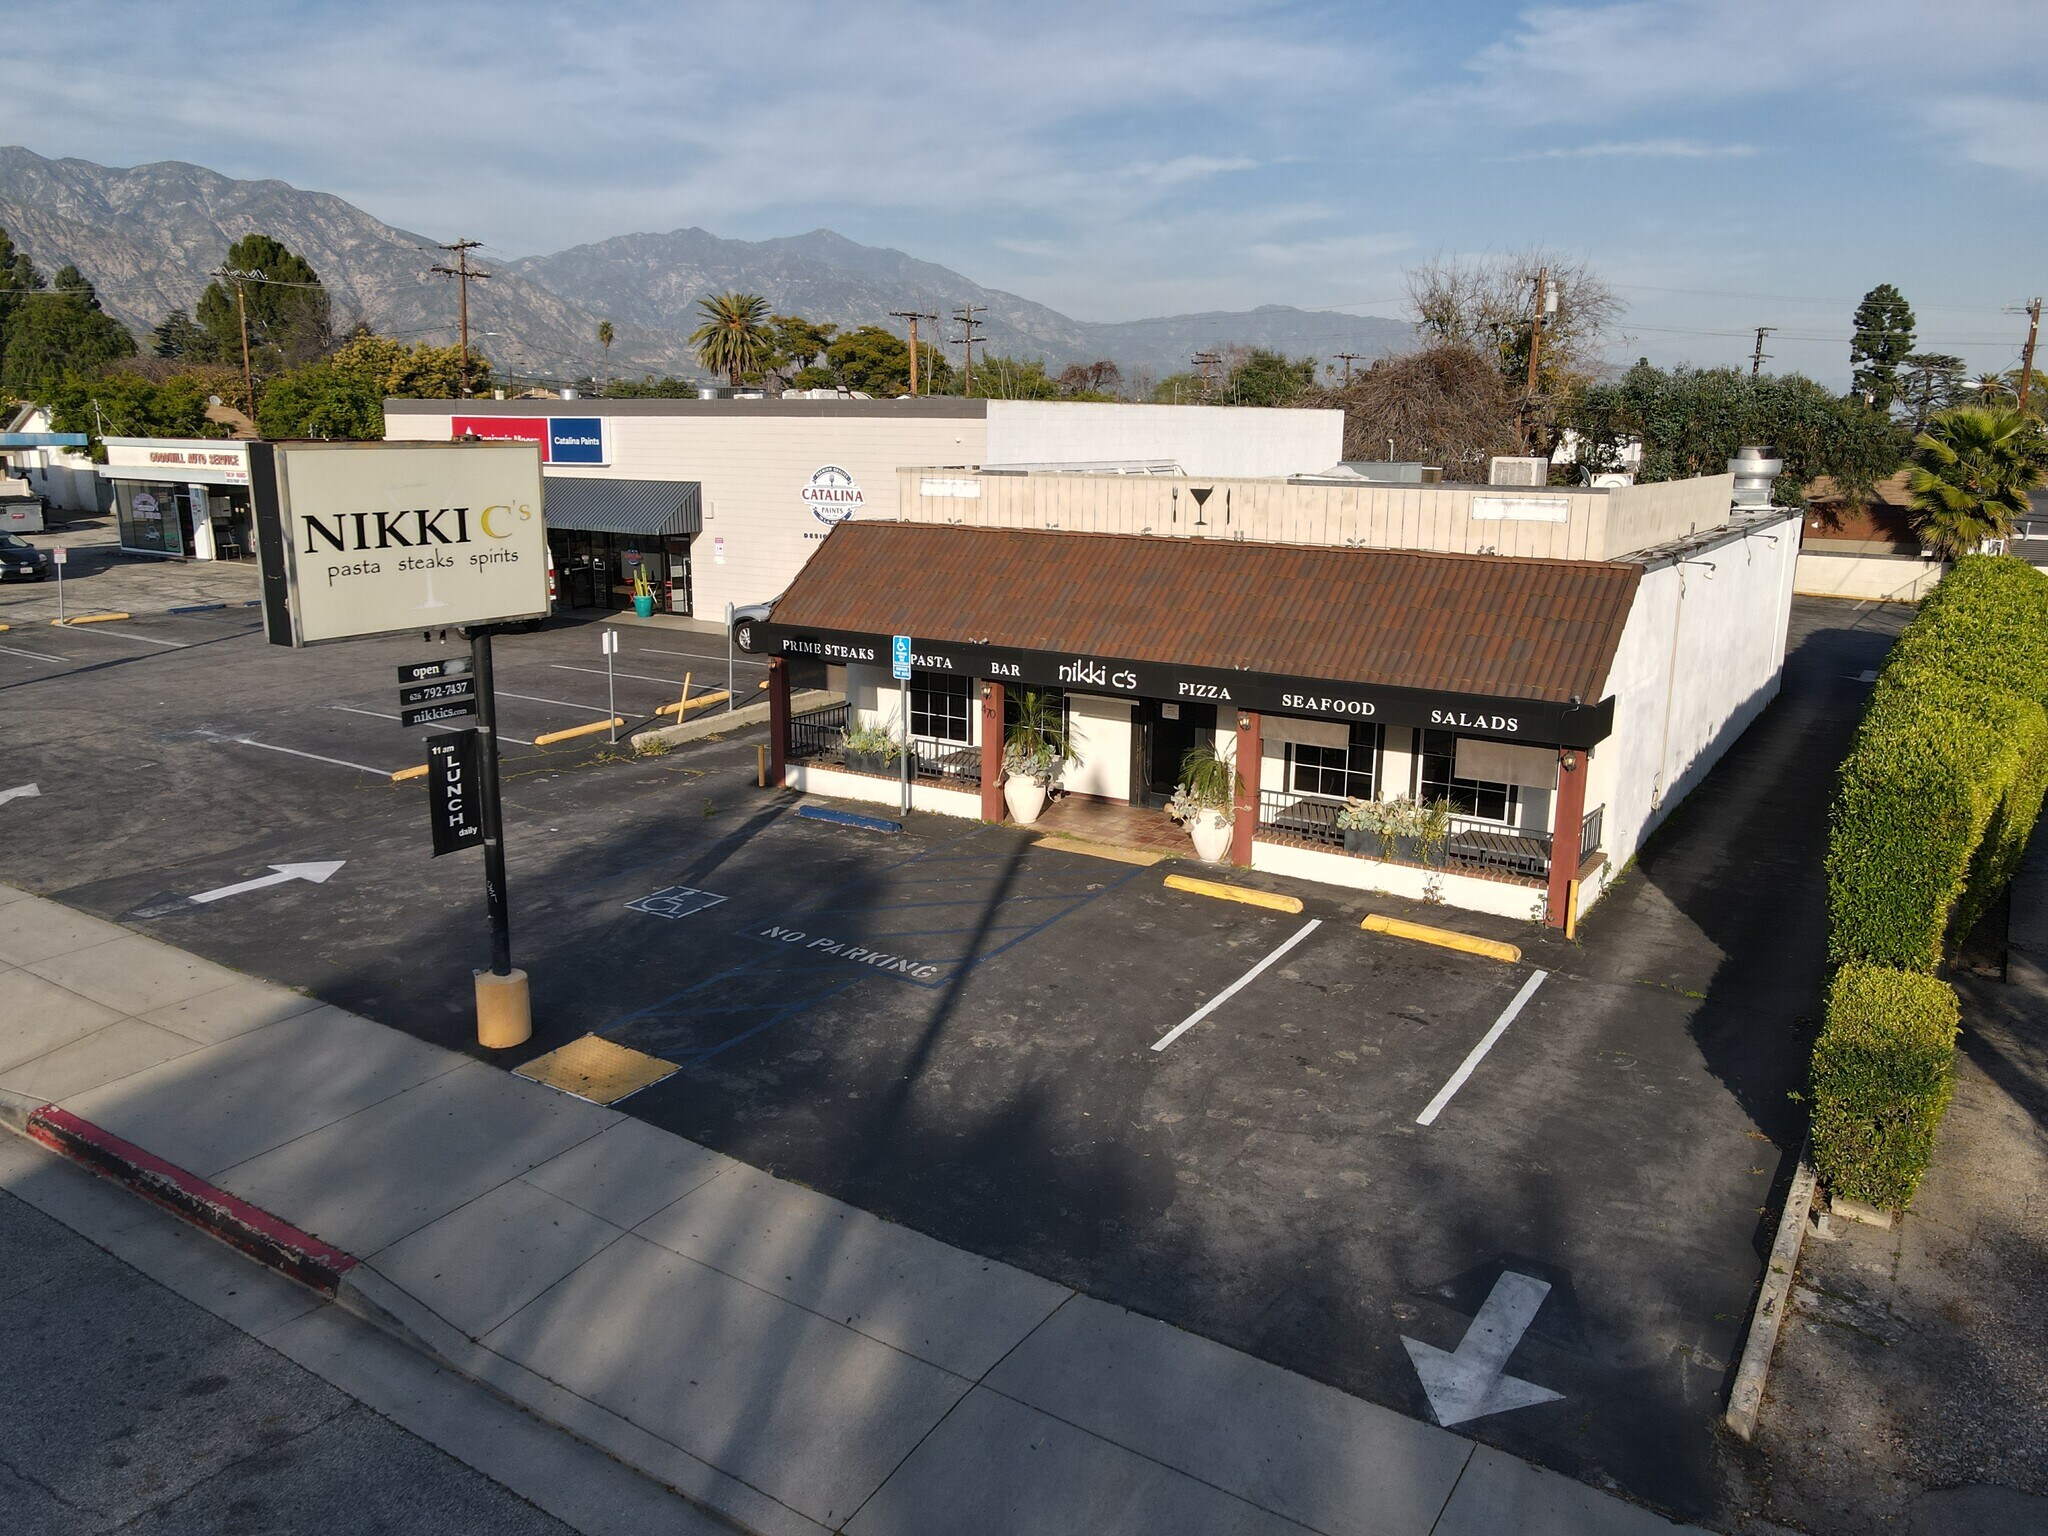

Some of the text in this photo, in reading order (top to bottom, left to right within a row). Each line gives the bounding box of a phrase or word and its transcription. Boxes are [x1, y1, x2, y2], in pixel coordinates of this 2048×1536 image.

[554, 436, 600, 445] Catalina Paints
[149, 452, 239, 466] GOODWILL AUTO SERVICE
[801, 488, 864, 502] CATALINA
[821, 506, 844, 515] PAINTS
[301, 499, 532, 554] NIKKI C's
[327, 547, 519, 587] pasta steaks spirits
[782, 639, 875, 660] PRIME STEAKS
[911, 653, 953, 669] PASTA
[990, 662, 1021, 677] BAR
[412, 665, 440, 679] open
[1058, 658, 1137, 690] nikki c's
[409, 681, 468, 701] 626 792-7437
[1178, 682, 1232, 700] PIZZA
[1281, 693, 1376, 716] SEAFOOD
[413, 707, 467, 724] nikkics.com
[1430, 709, 1519, 732] SALADS
[431, 745, 455, 755] 11 am
[446, 755, 464, 828] LUNCH
[458, 826, 478, 837] daily
[760, 926, 938, 978] NO PARKING
